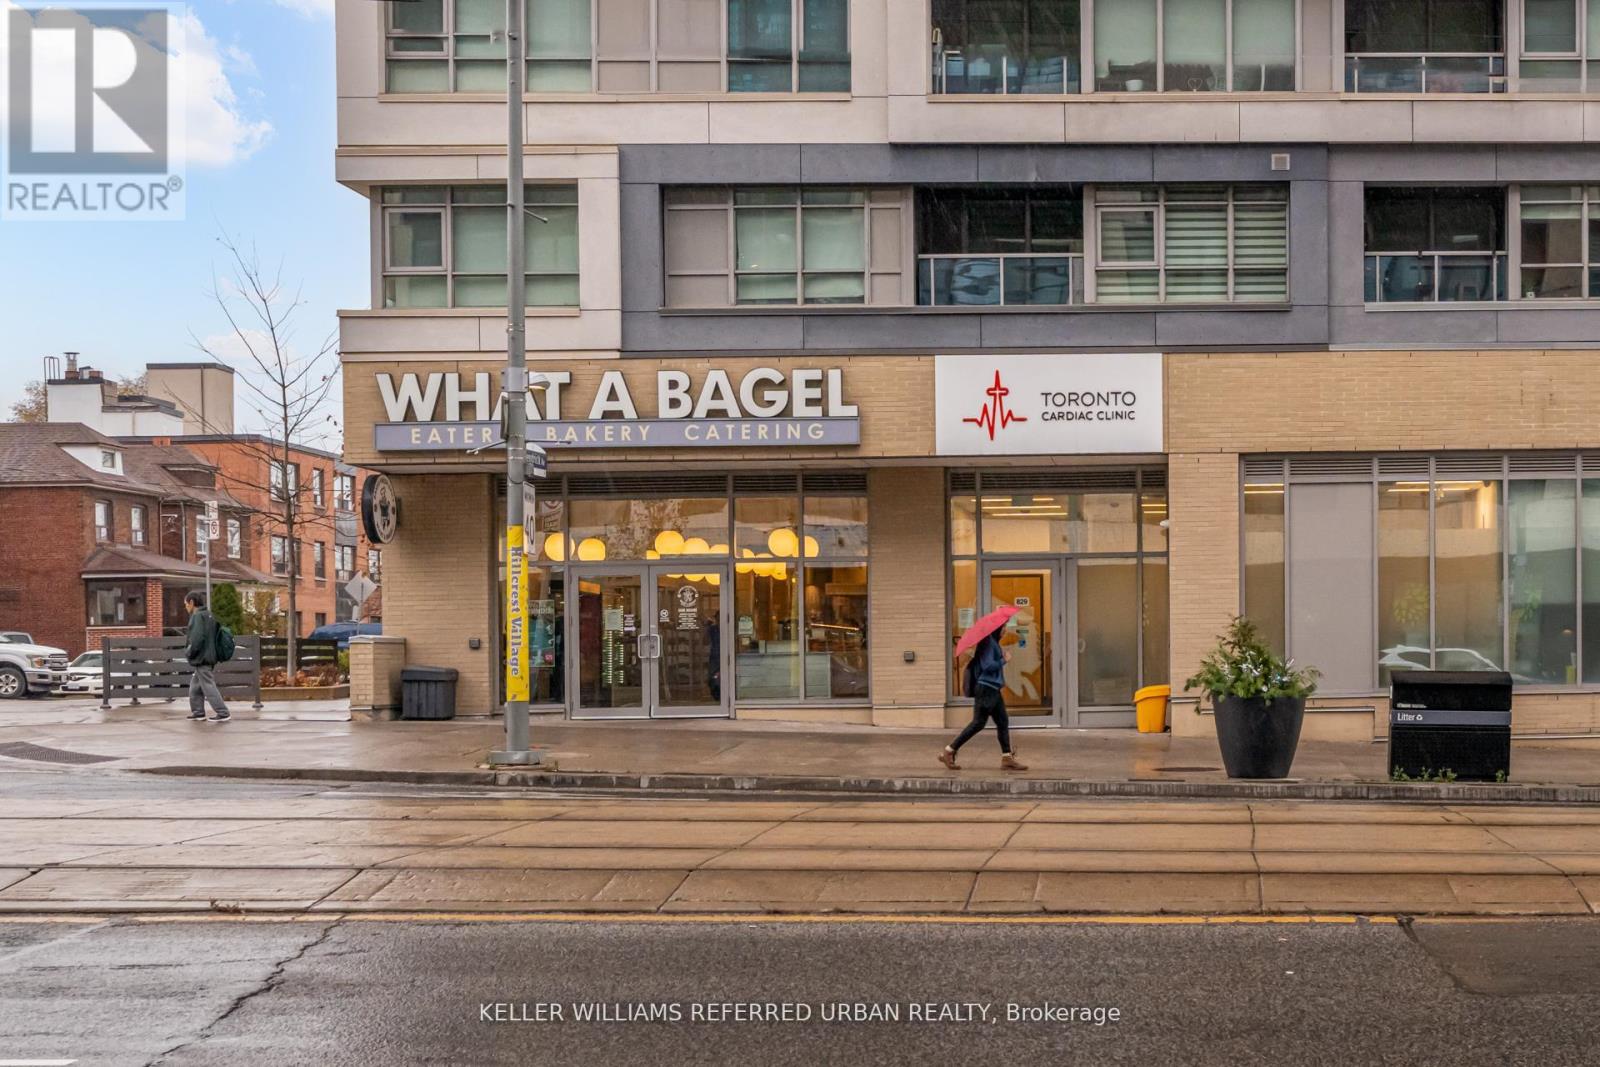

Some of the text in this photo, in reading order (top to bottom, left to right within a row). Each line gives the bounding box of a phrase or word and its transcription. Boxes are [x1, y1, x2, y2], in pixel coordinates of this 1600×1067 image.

[588, 370, 639, 419] A
[657, 367, 859, 418] BAGEL
[1040, 391, 1137, 407] TORONTO
[1041, 411, 1136, 421] CARDIAC CLINIC
[411, 423, 825, 445] EATER BAKERY CATERING
[525, 514, 535, 545] 40
[510, 546, 523, 677] Hillcrest Village
[1397, 712, 1415, 721] Litter
